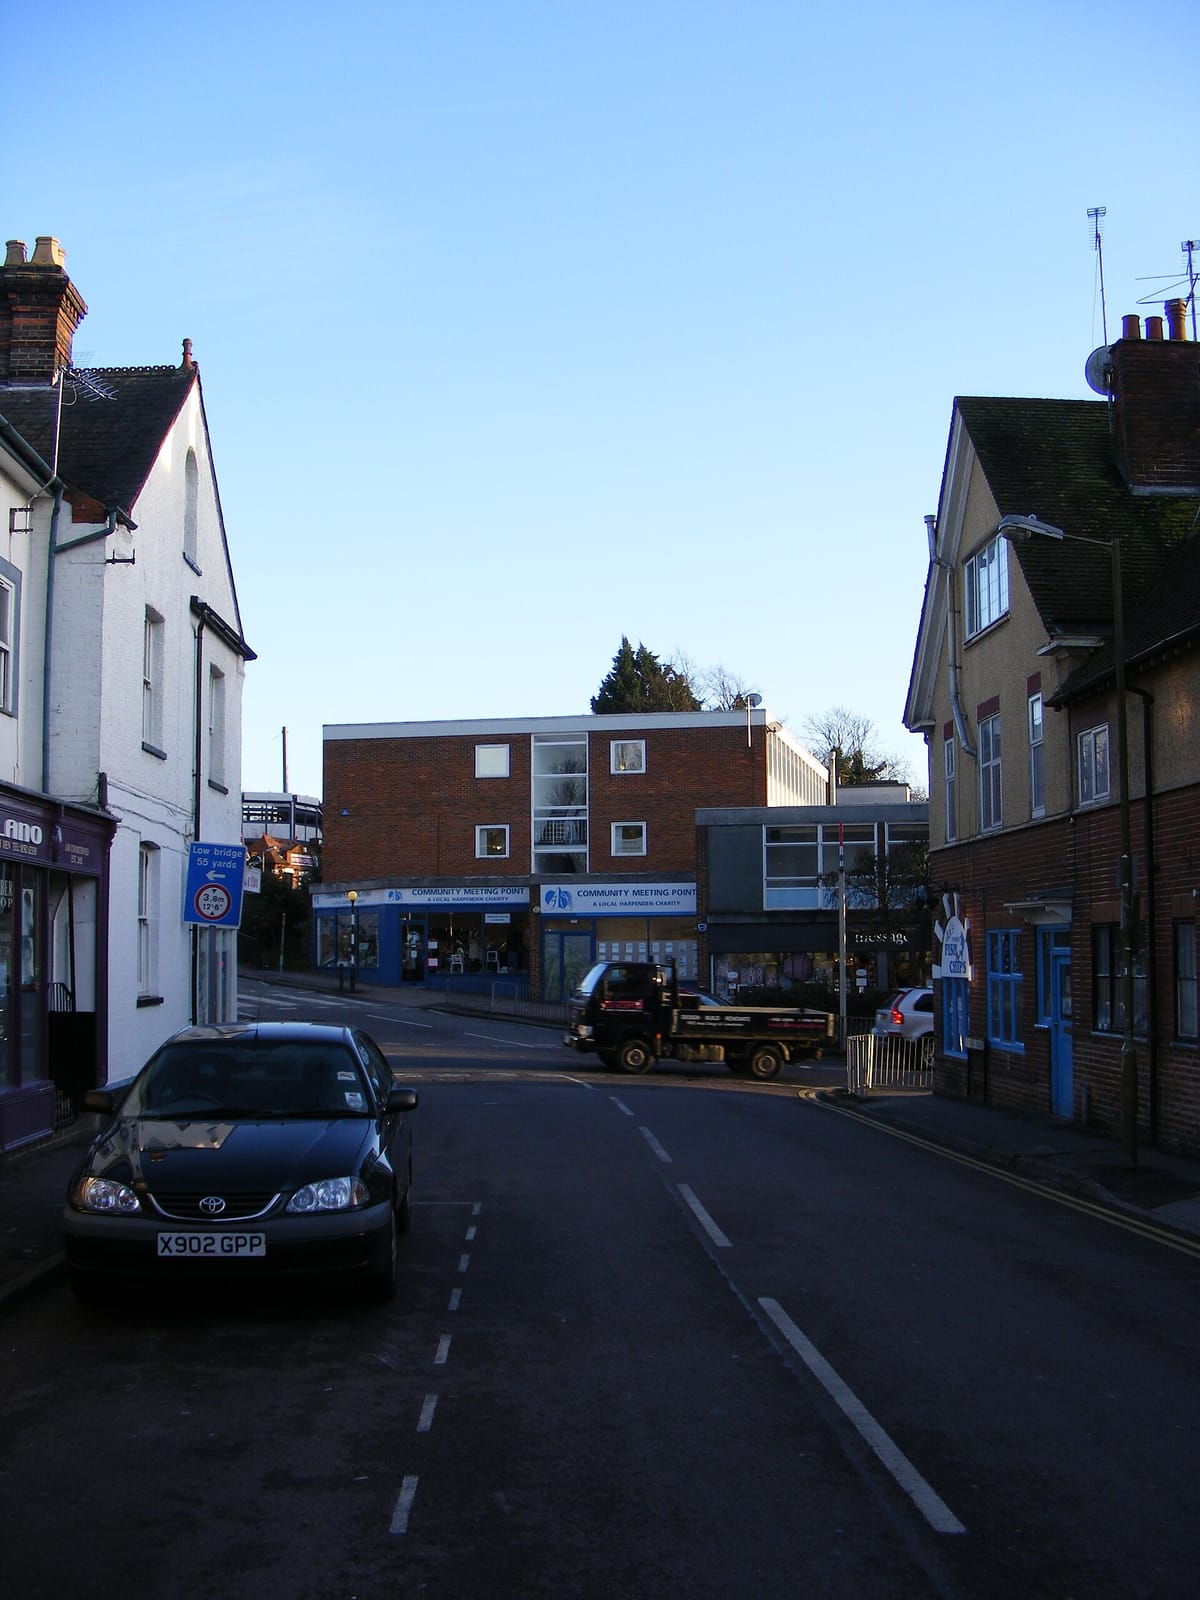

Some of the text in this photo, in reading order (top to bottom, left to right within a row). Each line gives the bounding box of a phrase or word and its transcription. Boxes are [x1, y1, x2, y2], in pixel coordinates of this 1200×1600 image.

[0, 819, 42, 844] ANO
[192, 846, 243, 859] Low bridge
[196, 857, 237, 869] 55 yards
[412, 887, 525, 896] COMMUNITY MEETING POINT
[577, 888, 696, 898] COMMUNITY MEETING POINT
[203, 893, 224, 903] 3.8m
[160, 1235, 262, 1253] X902 GPP
